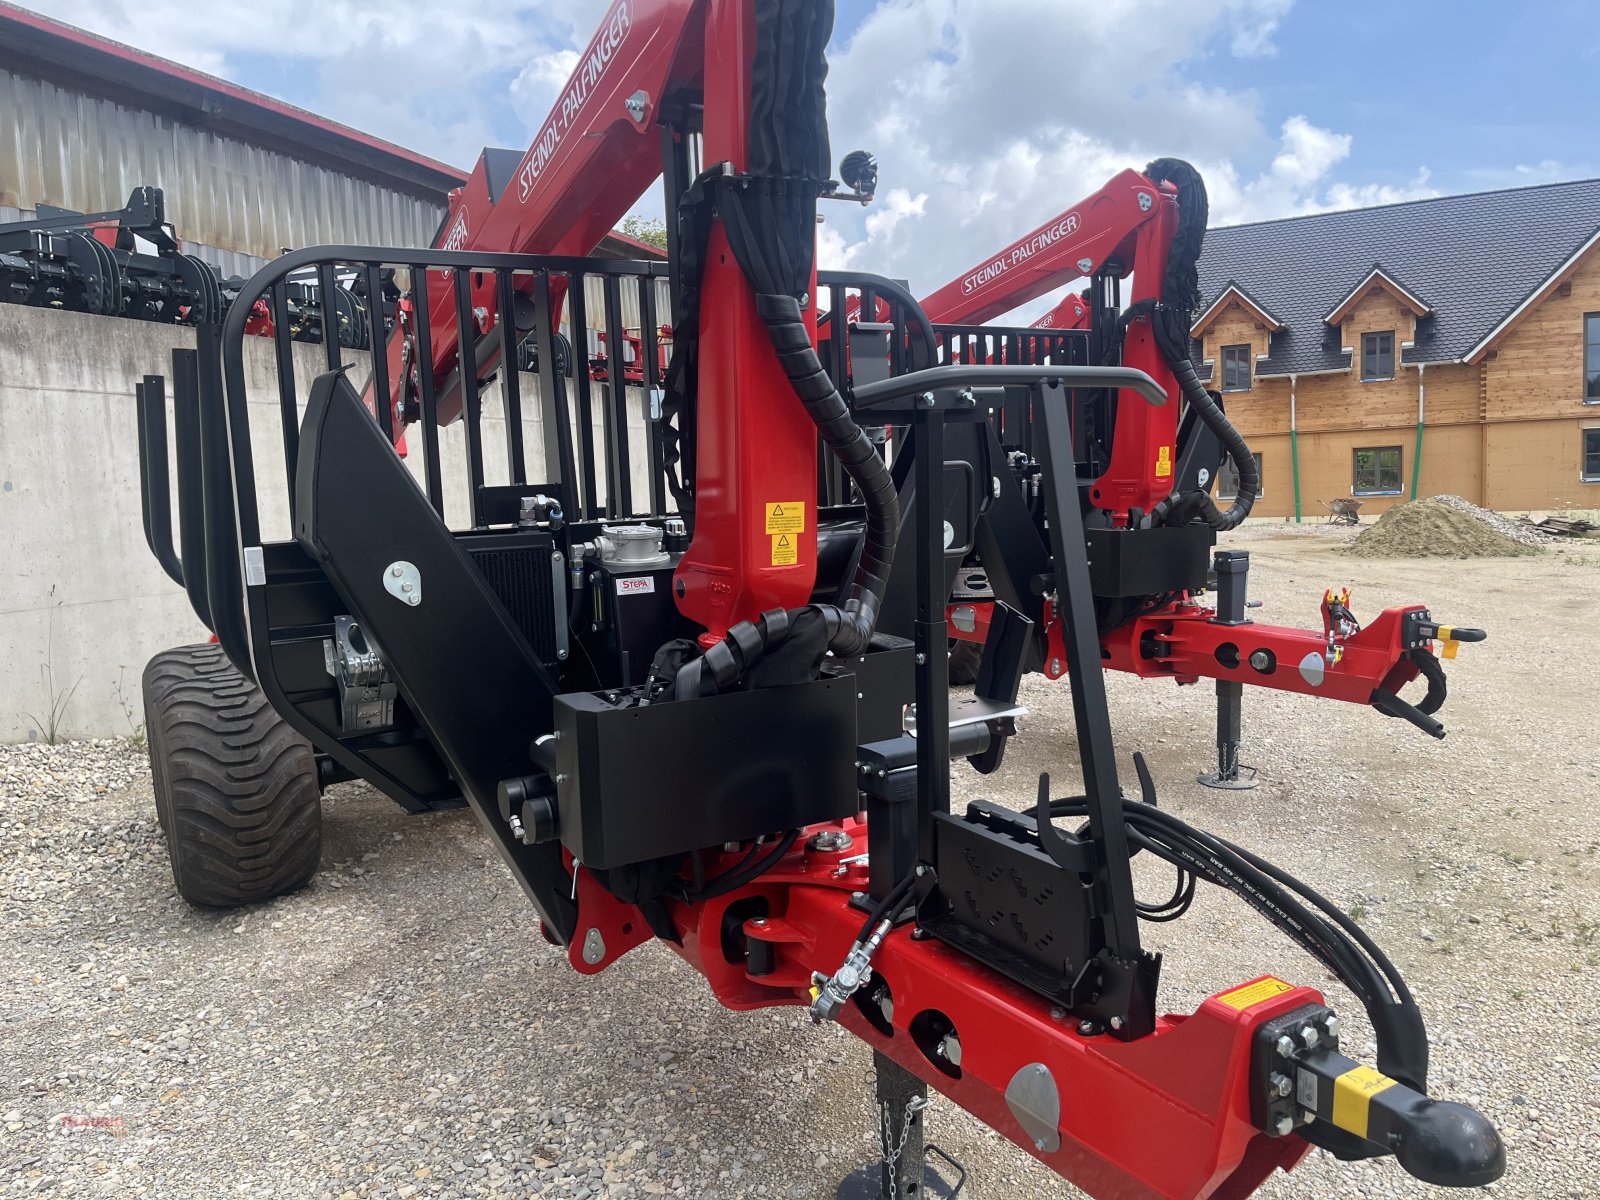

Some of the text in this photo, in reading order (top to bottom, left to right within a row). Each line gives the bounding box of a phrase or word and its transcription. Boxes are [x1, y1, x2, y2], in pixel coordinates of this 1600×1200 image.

[520, 1, 631, 197] STEINDL-PALFINGER
[964, 216, 1077, 292] STEINDL-PALFINGER
[622, 580, 648, 589] STEPA
